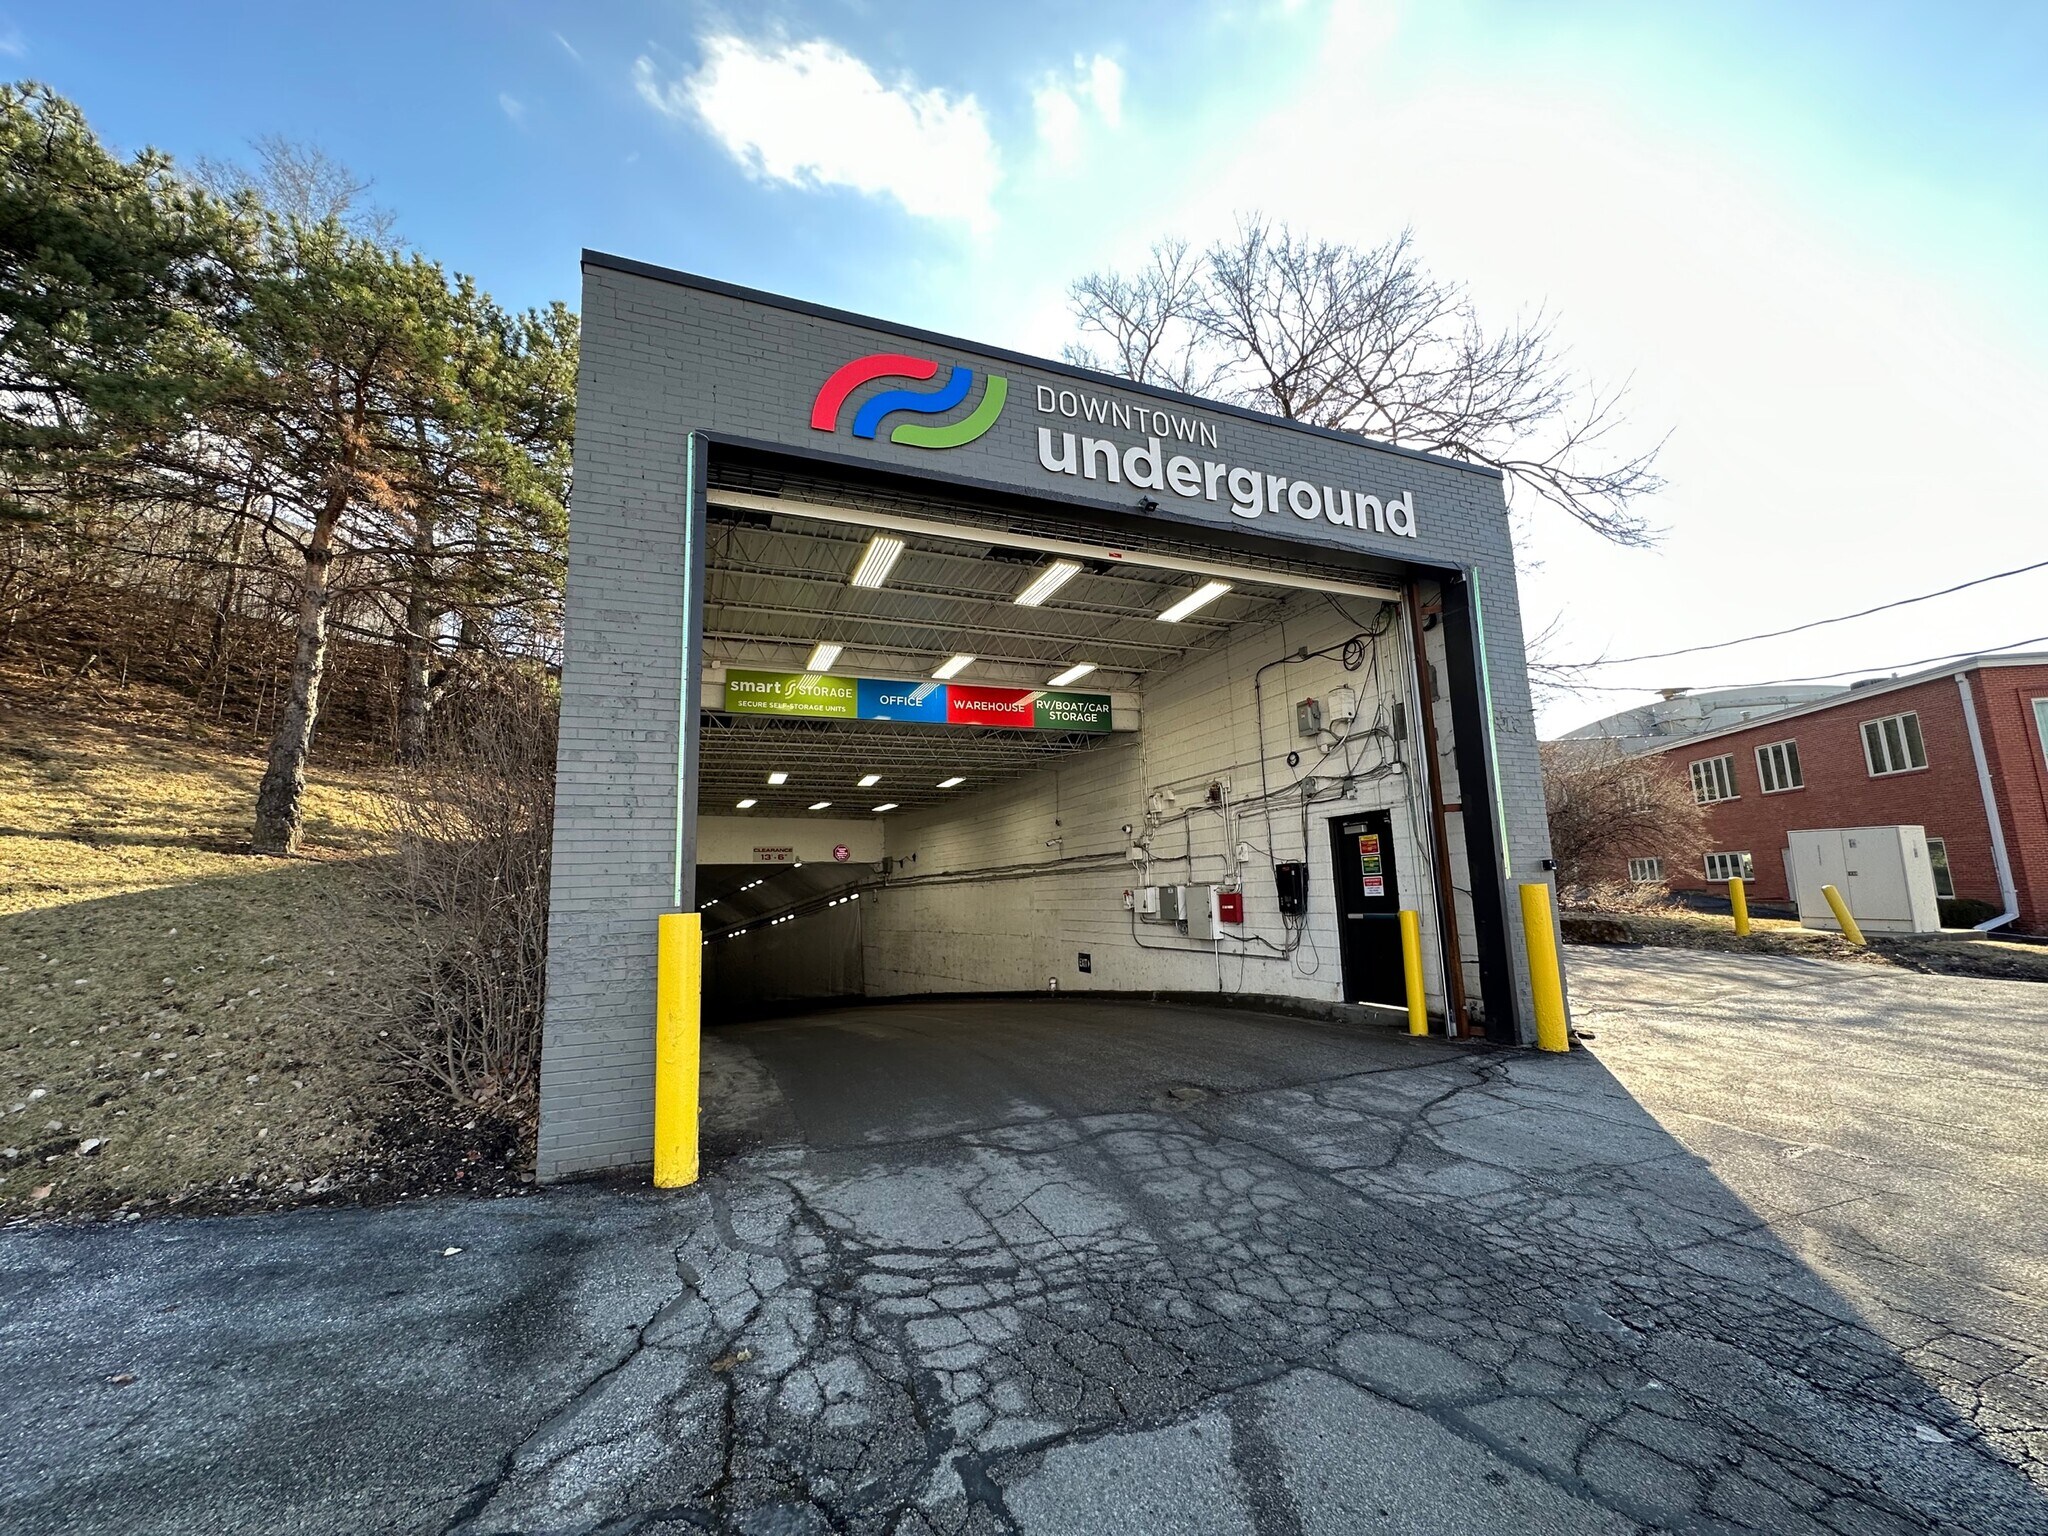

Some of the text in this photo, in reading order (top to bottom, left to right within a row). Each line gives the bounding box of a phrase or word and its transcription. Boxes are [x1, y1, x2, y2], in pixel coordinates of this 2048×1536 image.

[1036, 384, 1218, 449] DOWNTOWN
[1037, 427, 1417, 538] underground
[730, 680, 853, 698] smart STORAGE
[738, 700, 846, 713] SECURE SELF-STORAGE UNITS
[879, 695, 923, 707] OFFICE
[953, 700, 1025, 713] WAREHOUSE
[1036, 700, 1109, 713] RV/BOAT/CAR
[1049, 711, 1098, 723] STORAGE
